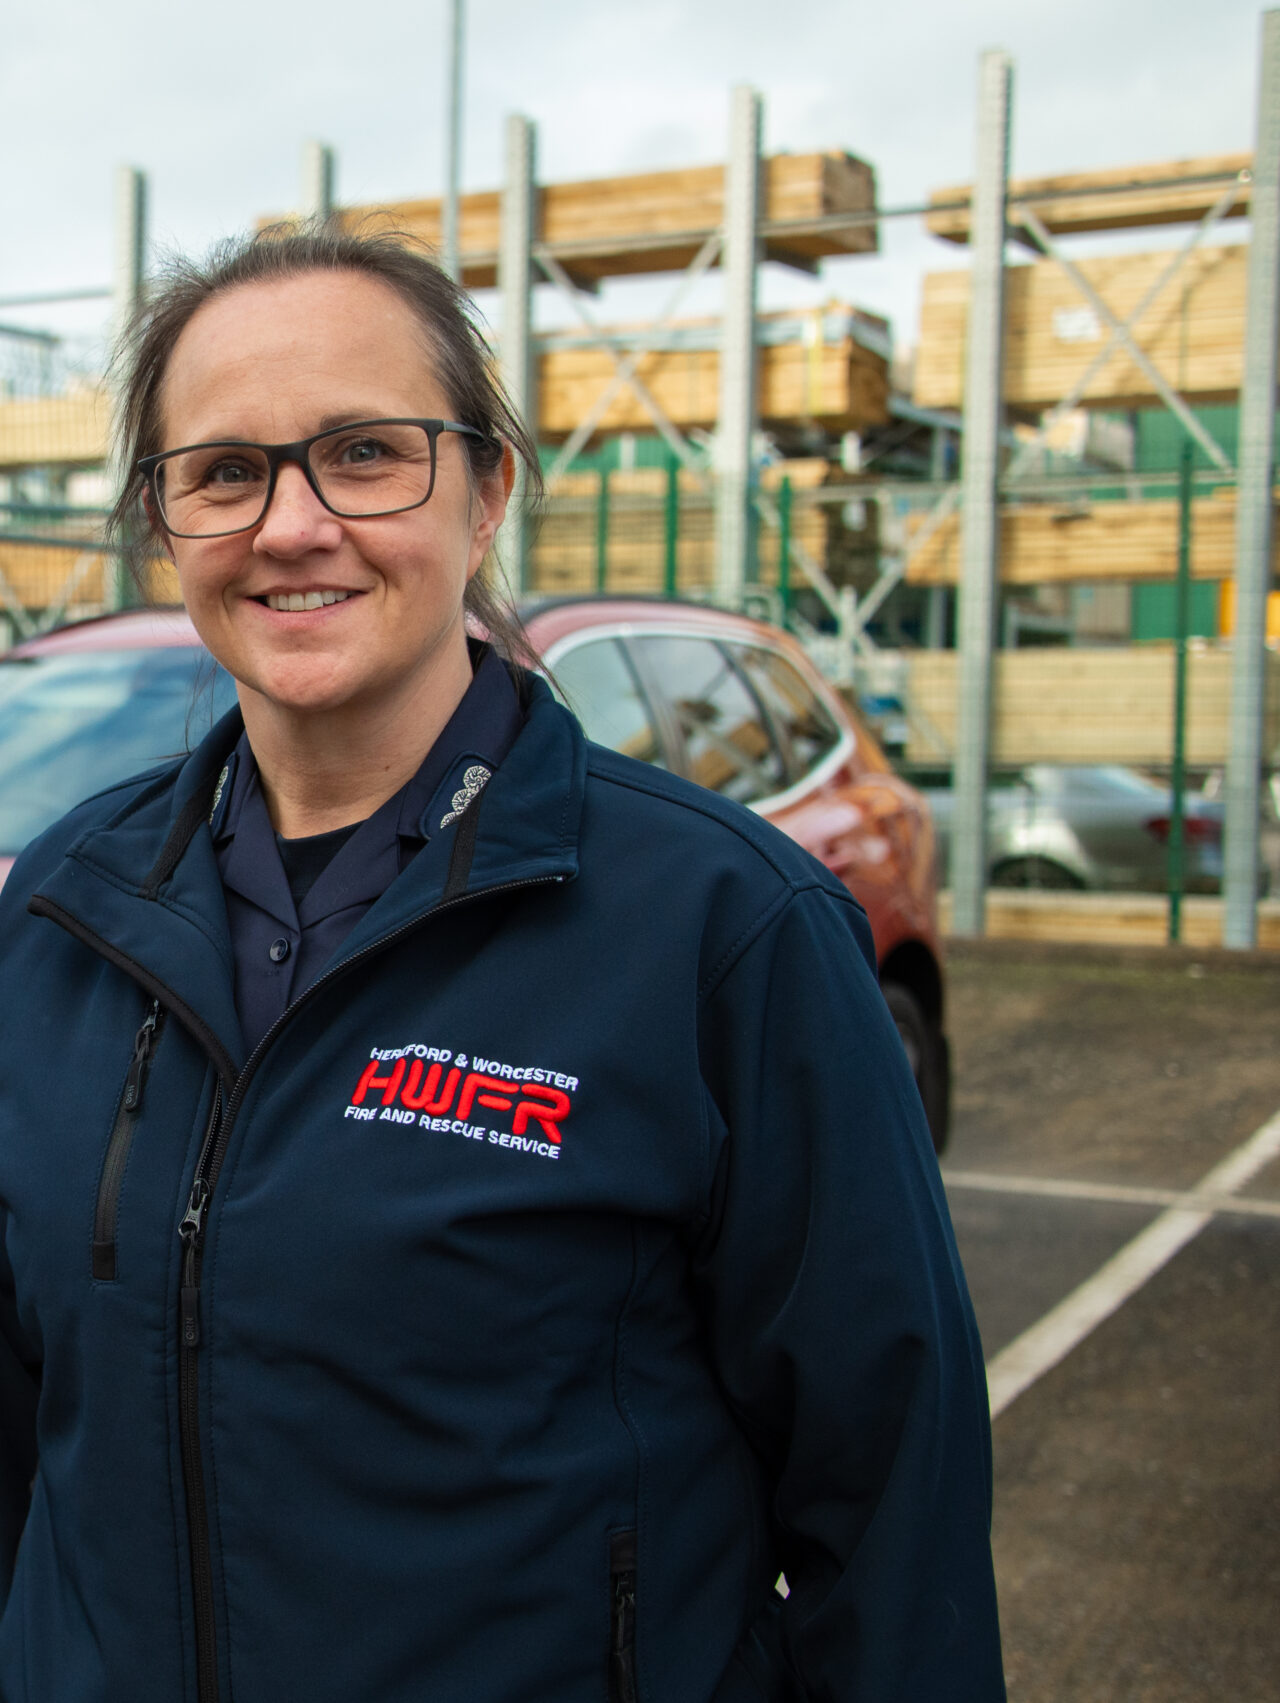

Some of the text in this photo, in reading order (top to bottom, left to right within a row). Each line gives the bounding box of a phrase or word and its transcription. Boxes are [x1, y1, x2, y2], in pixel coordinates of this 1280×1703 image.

[370, 1044, 579, 1092] HERFORD & WORCESTER
[351, 1057, 571, 1144] HWFR
[344, 1105, 562, 1159] FIRE AND RESCUE SERVICE
